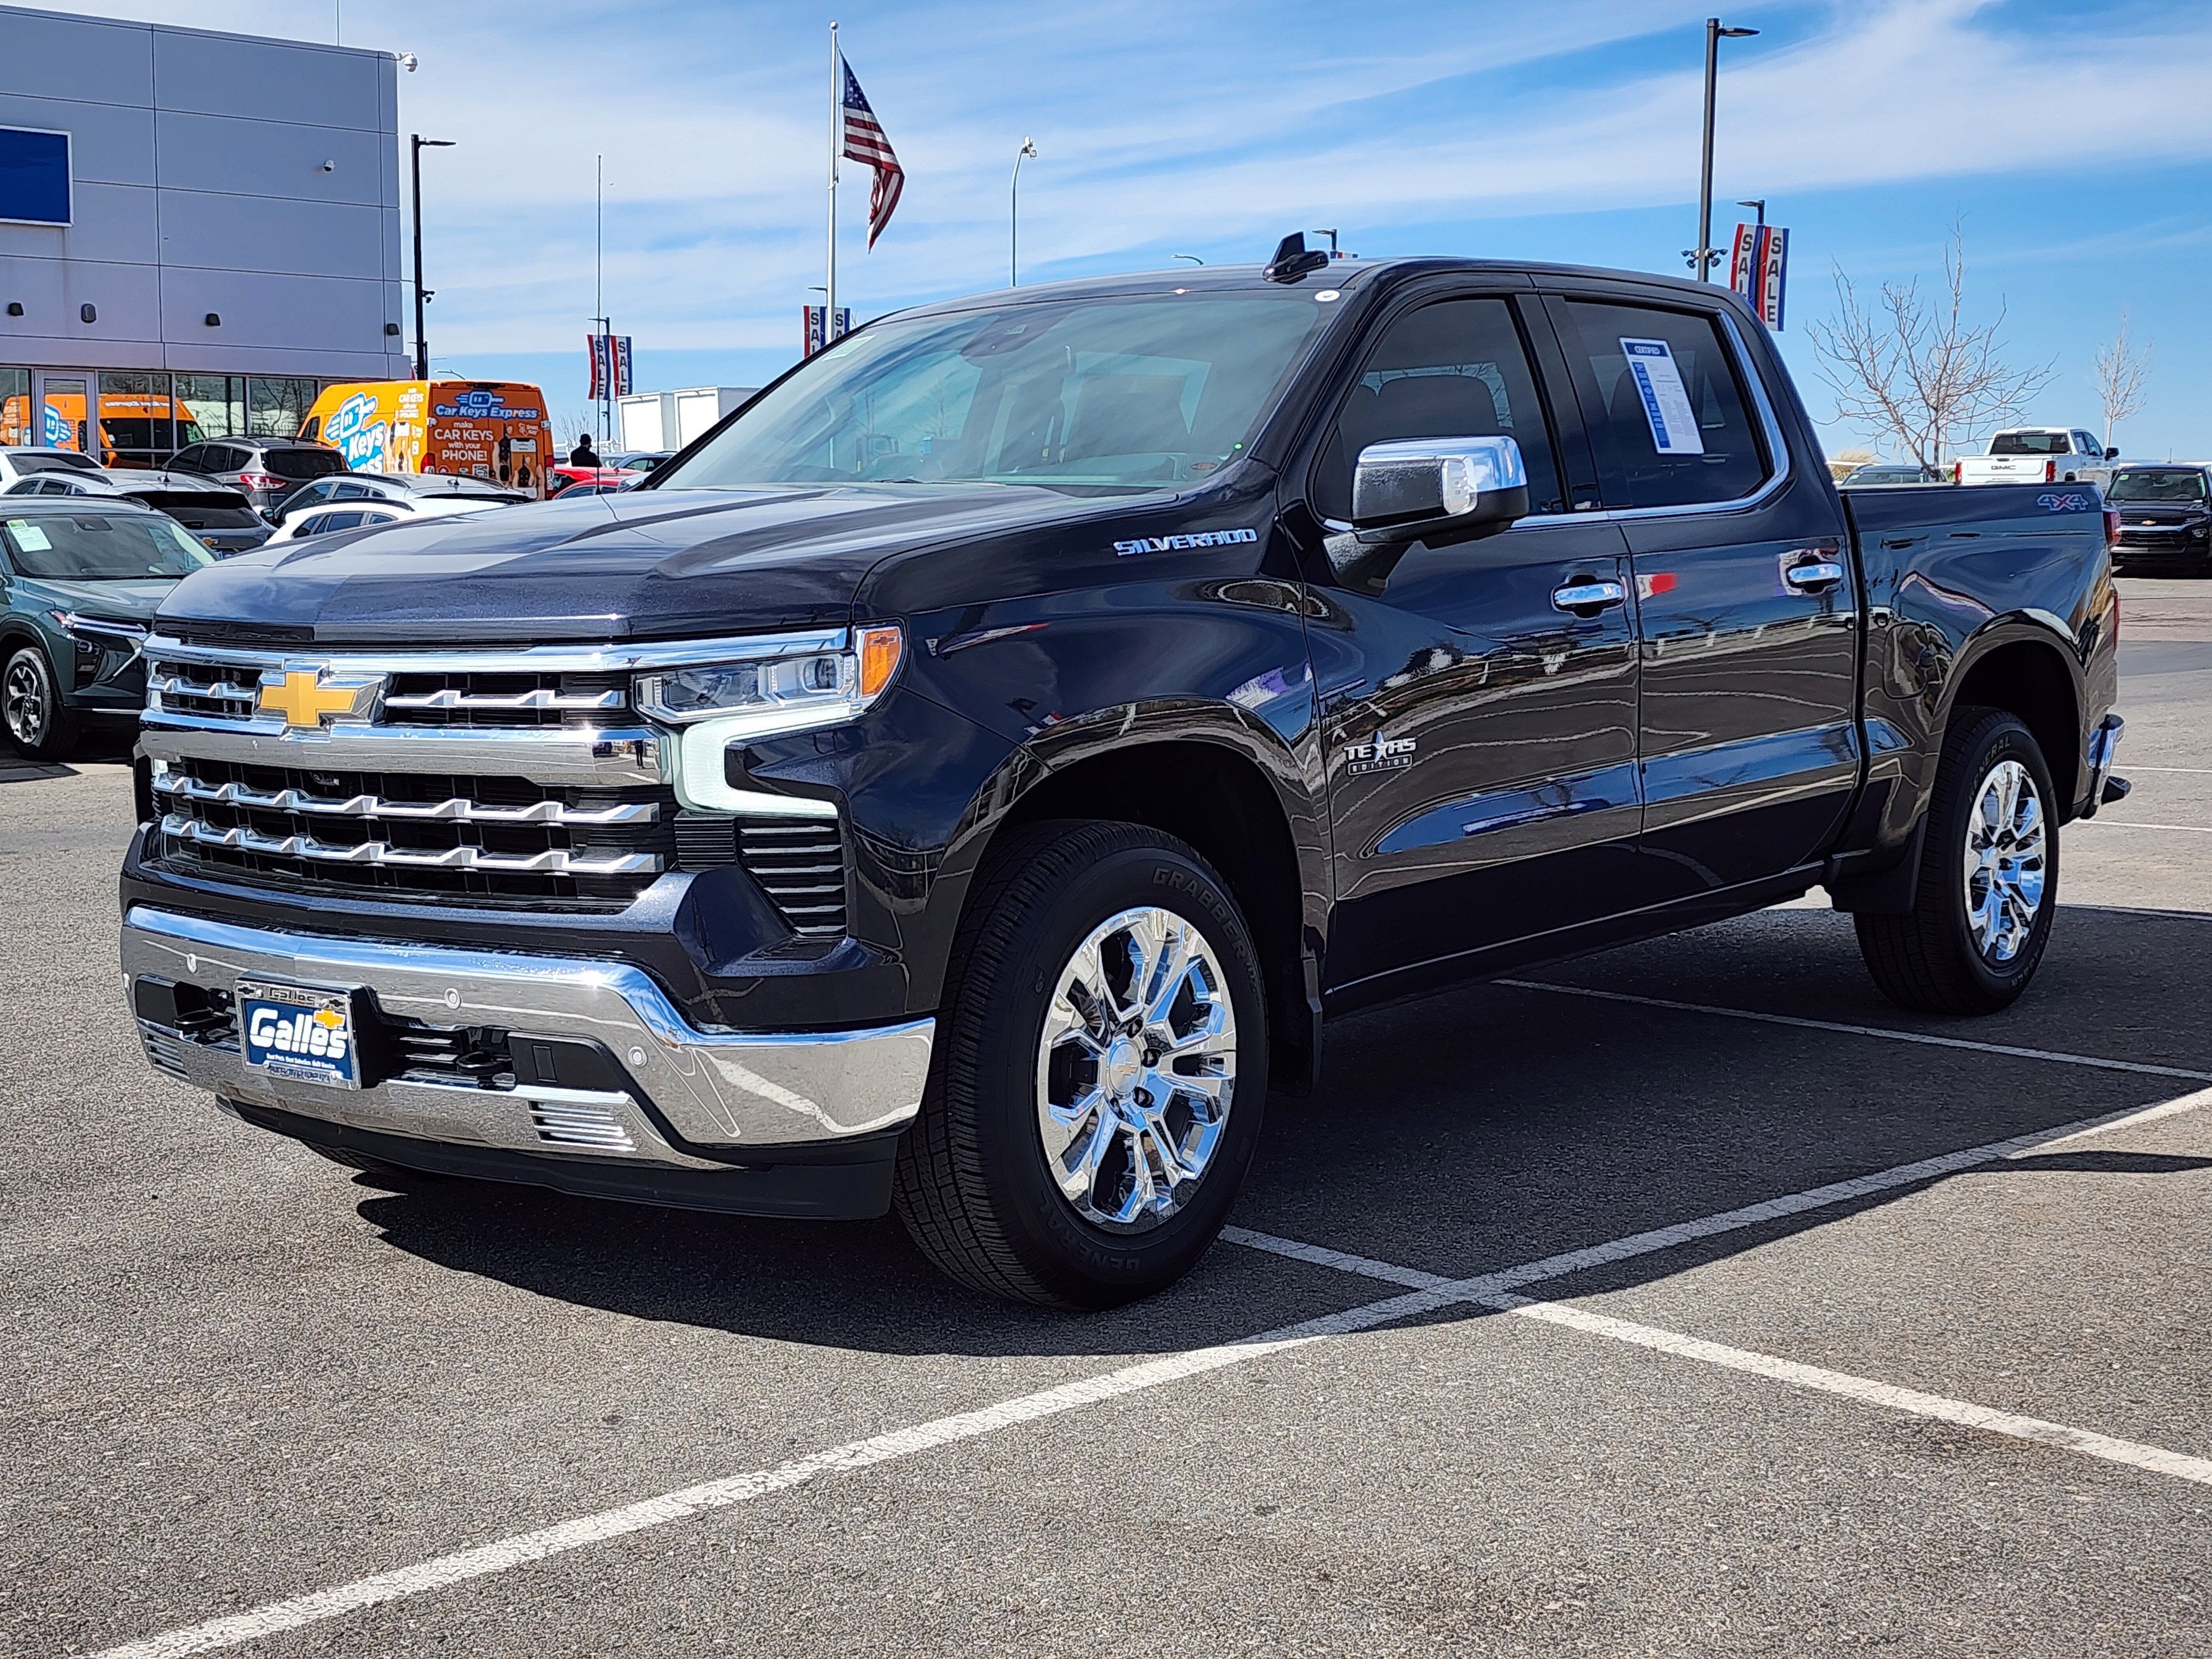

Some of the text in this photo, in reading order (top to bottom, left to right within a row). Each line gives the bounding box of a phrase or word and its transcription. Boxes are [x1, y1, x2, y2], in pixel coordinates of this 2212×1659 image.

[1738, 233, 1753, 298] SAL
[1767, 237, 1782, 322] SALE
[811, 312, 820, 352] SA
[835, 314, 843, 338] SA
[595, 341, 606, 395] SALE
[618, 342, 627, 395] SALE
[435, 405, 538, 419] Car Keys Express
[348, 425, 384, 462] Keys
[434, 429, 461, 440] CAR
[463, 430, 494, 441] KEYS
[442, 450, 488, 461] PHONE!
[1113, 528, 1258, 556] SILVERADO
[1344, 732, 1416, 761] TEXAS
[1353, 757, 1408, 772] EDITION
[1152, 867, 1247, 959] GRABBER
[269, 987, 315, 1005] Galles
[249, 1008, 348, 1059] Galles
